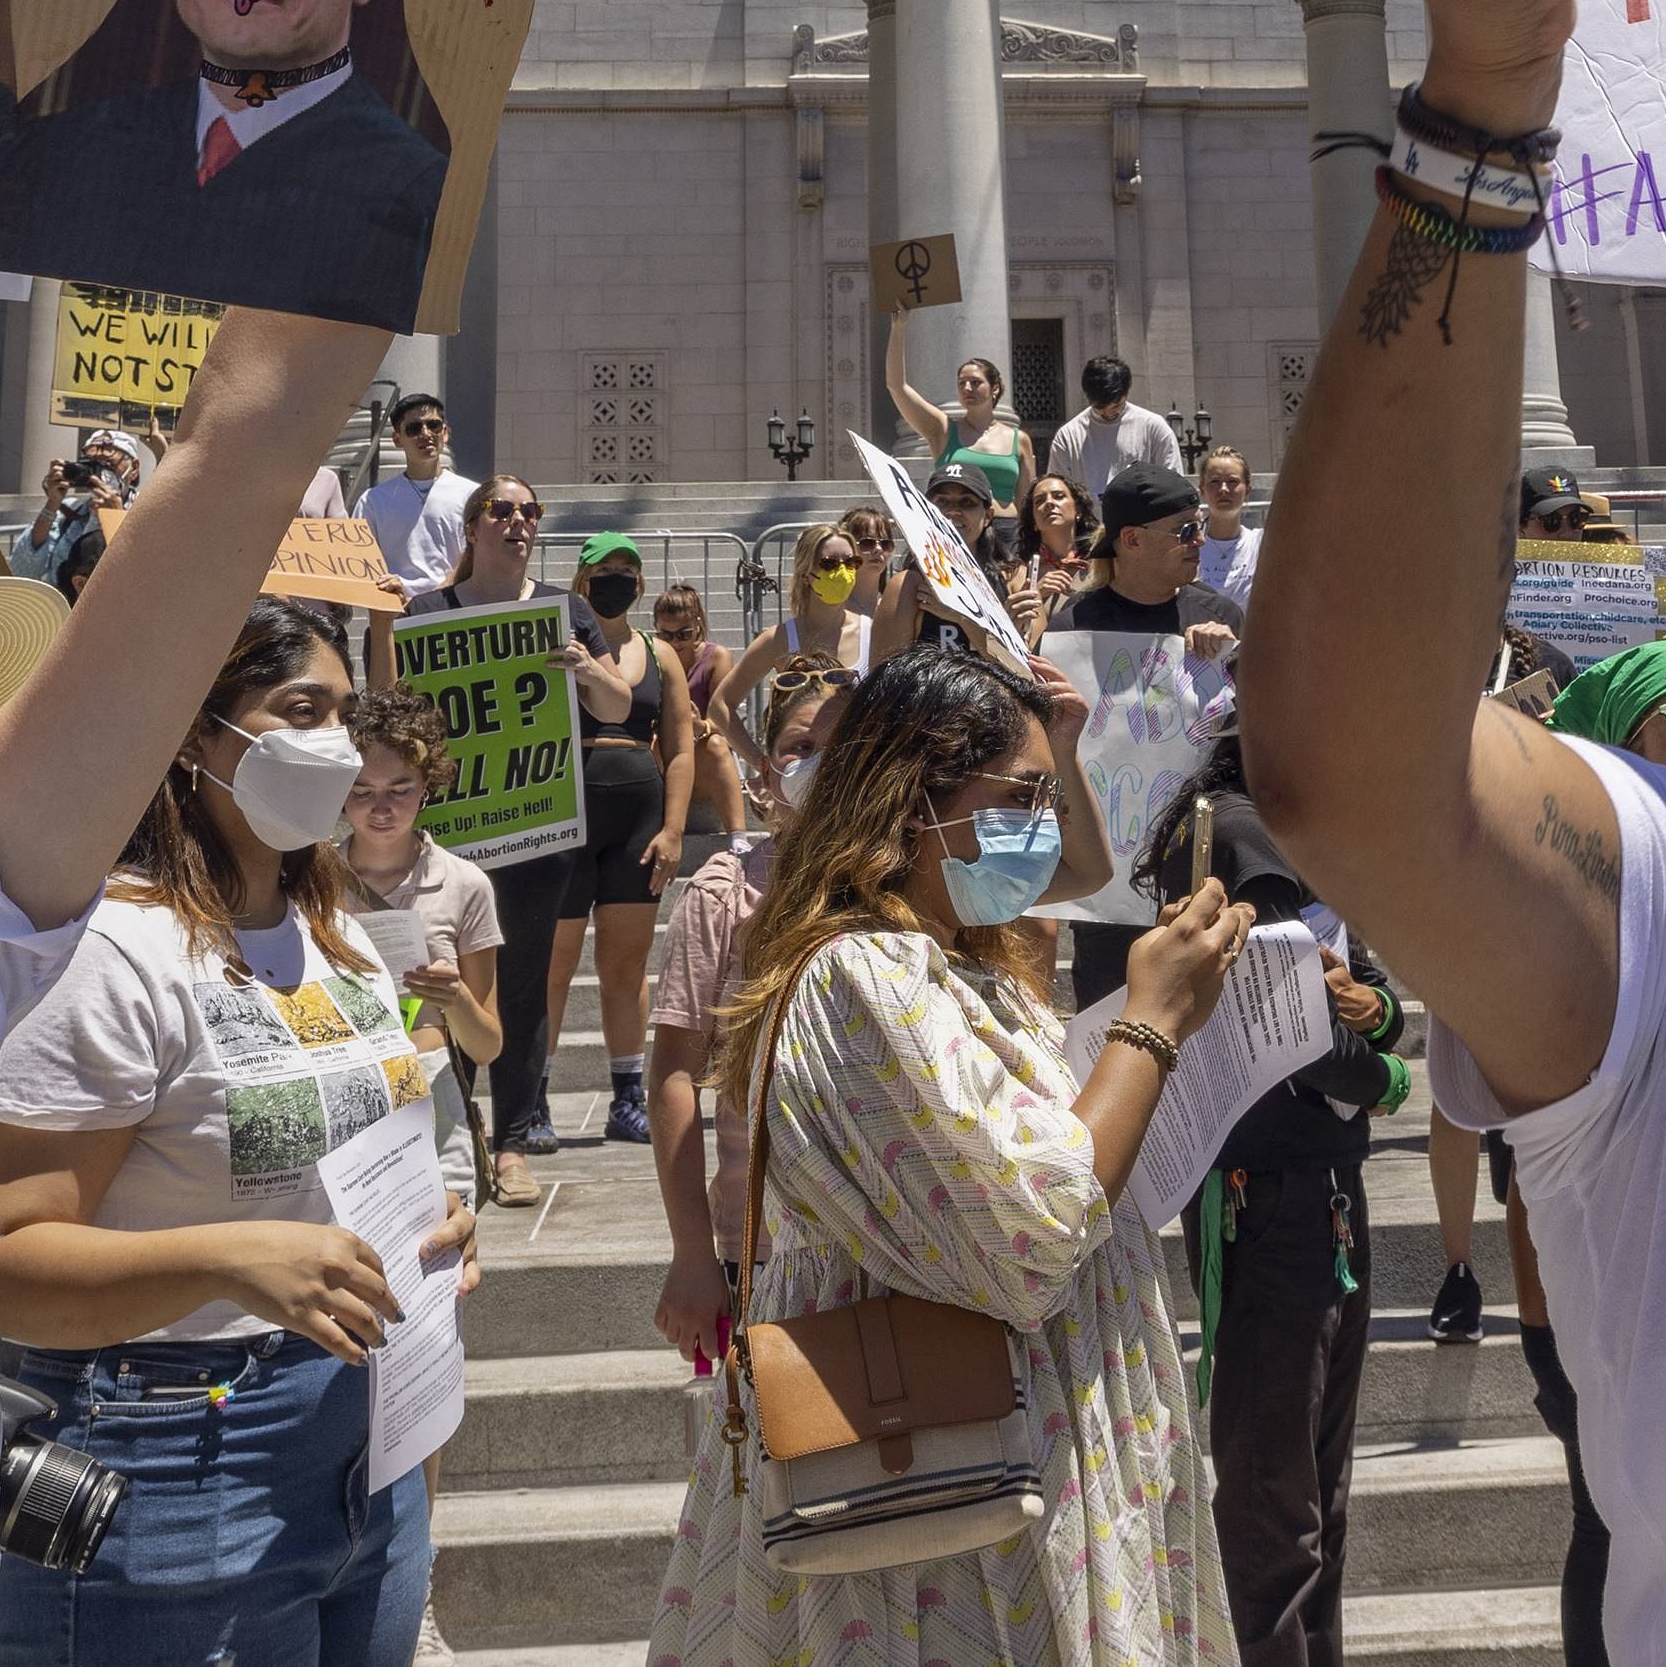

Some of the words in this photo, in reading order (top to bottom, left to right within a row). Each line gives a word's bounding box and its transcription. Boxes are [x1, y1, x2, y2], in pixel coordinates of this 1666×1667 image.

[69, 309, 127, 345] WE
[72, 351, 150, 388] NOT
[1572, 564, 1647, 583] RESOURCES
[1584, 593, 1659, 609] prochoice.org
[429, 680, 503, 742] OE
[504, 737, 573, 793] NO!
[454, 814, 478, 833] Up!
[481, 807, 520, 828] Raise
[523, 797, 554, 817] Hell!
[223, 1054, 270, 1070] Yosemite
[235, 1171, 303, 1190] Yellowstone
